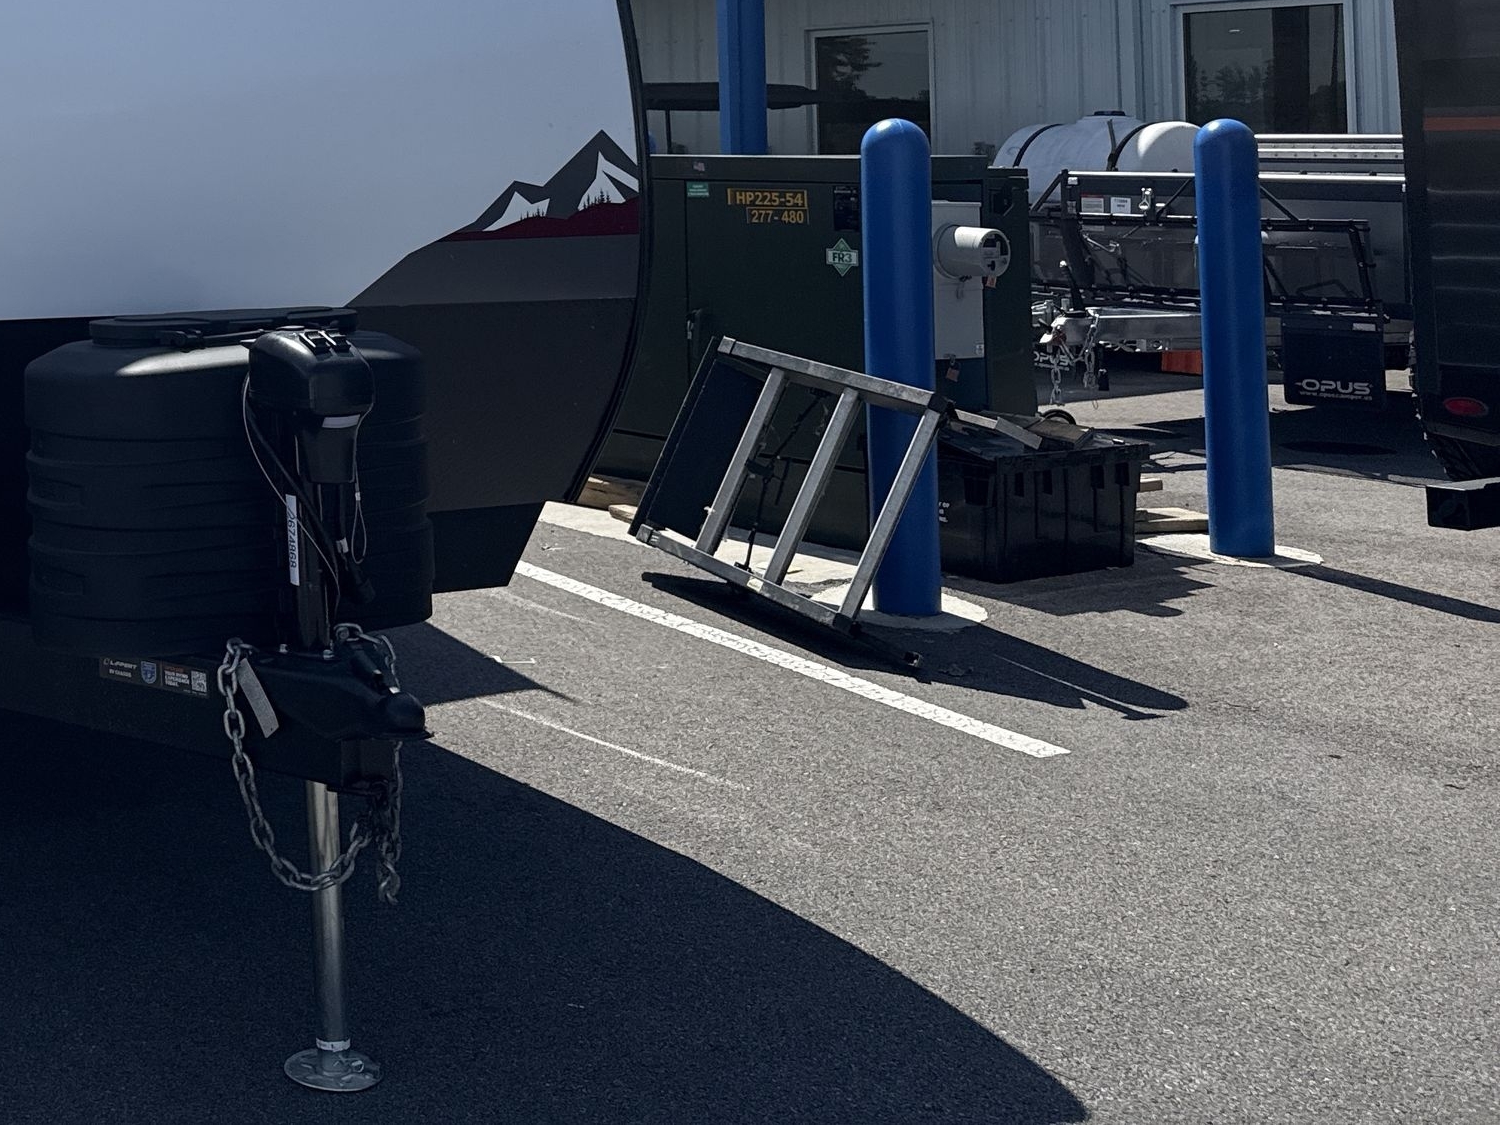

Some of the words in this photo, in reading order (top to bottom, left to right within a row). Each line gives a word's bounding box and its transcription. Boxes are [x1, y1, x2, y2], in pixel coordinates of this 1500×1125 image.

[736, 191, 804, 207] HP225-54
[832, 251, 853, 263] FR3
[1301, 378, 1371, 395] OPUS
